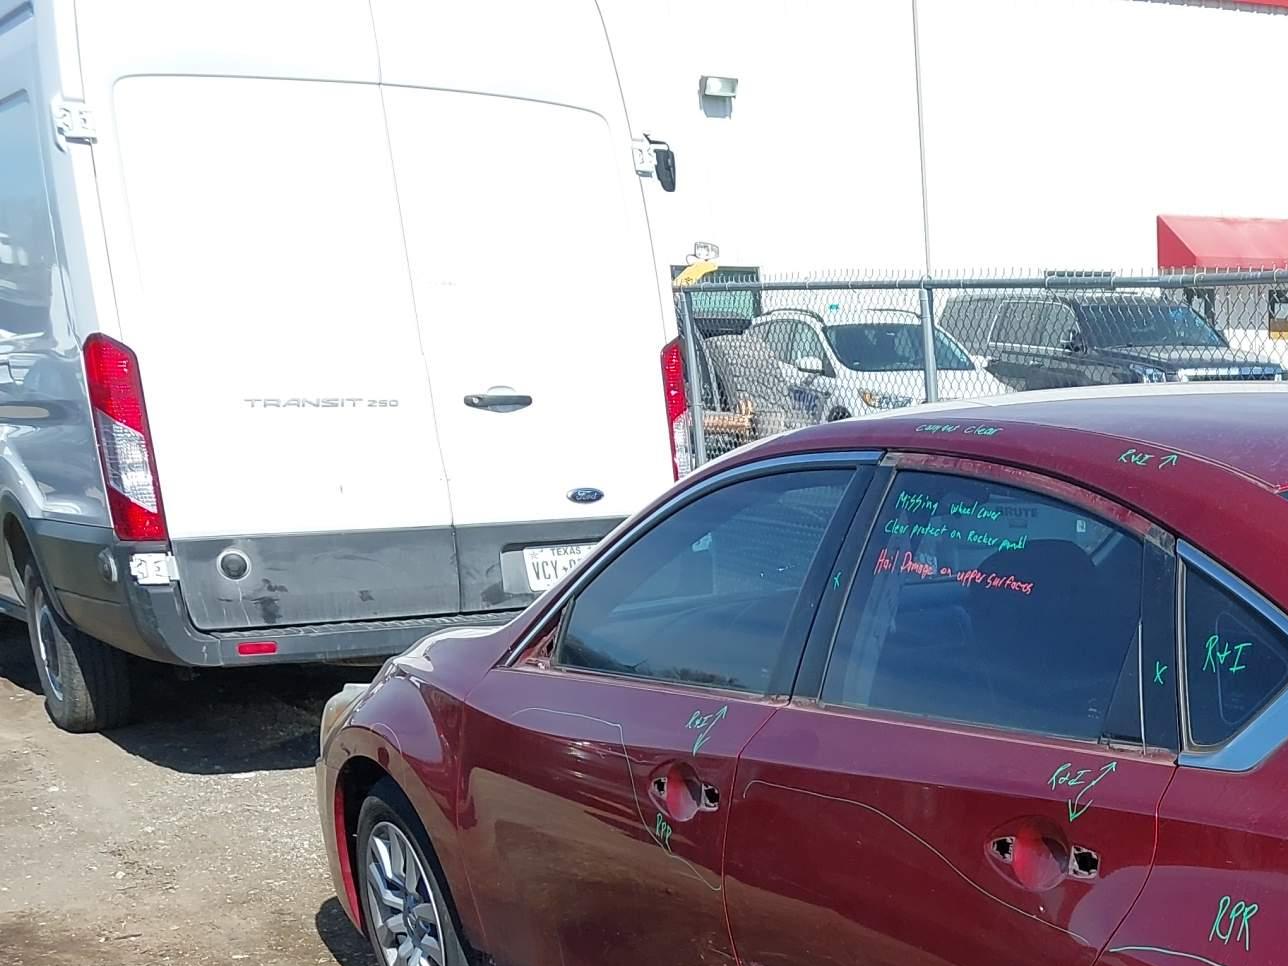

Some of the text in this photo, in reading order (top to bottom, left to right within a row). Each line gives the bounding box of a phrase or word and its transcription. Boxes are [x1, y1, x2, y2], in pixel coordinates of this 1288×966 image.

[244, 398, 399, 408] TRANSIT 250
[550, 546, 582, 557] TEXAS
